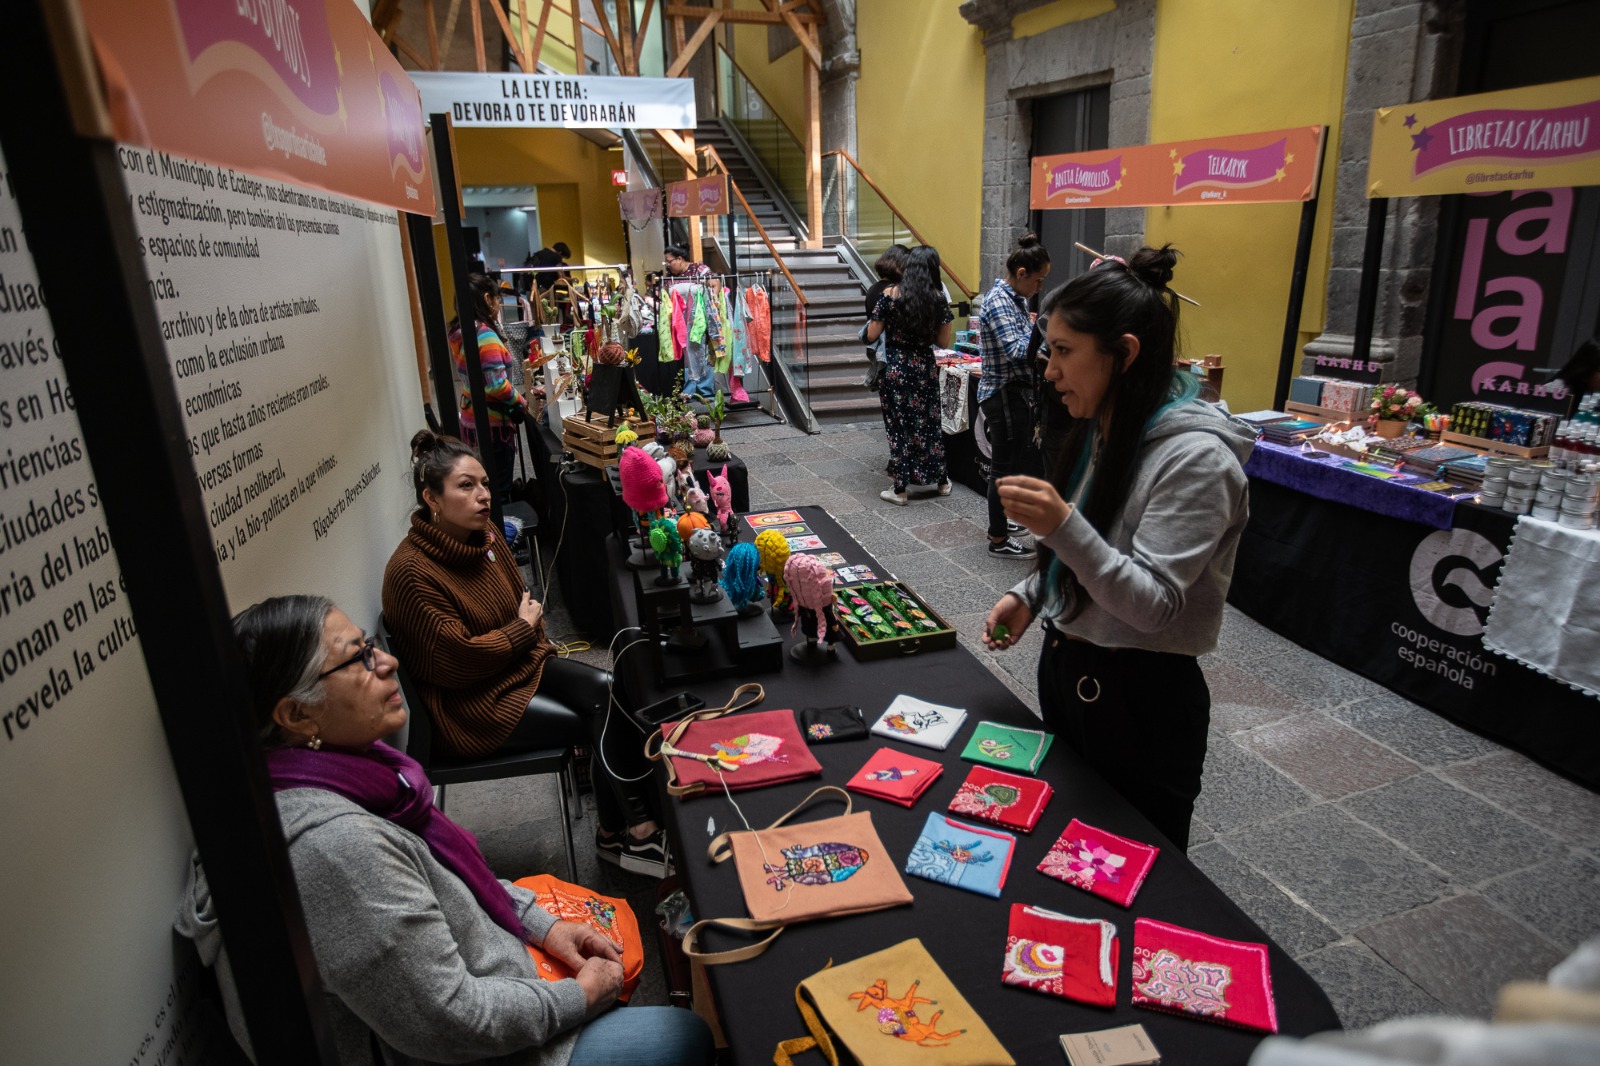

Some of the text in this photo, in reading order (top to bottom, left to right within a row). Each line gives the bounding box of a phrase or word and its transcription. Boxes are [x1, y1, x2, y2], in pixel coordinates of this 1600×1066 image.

[502, 80, 588, 100] LA LEY ERA:
[452, 102, 636, 122] DEVORA O TE DEVORARÁN
[1449, 117, 1590, 155] LIBRETAS KARHU
[118, 147, 144, 174] con
[146, 148, 158, 176] el
[158, 150, 214, 192] Municipio
[217, 166, 228, 190] de
[228, 169, 267, 202] Ecatepec,
[266, 186, 278, 202] nos
[311, 196, 318, 210] en
[1055, 167, 1110, 188] ANITA EMBROLLOS
[1208, 154, 1248, 178] TELKARYK
[138, 190, 226, 226] estigmatización,
[226, 208, 247, 230] pero
[246, 208, 276, 230] también
[286, 212, 296, 232] las
[296, 217, 322, 236] presencias
[148, 232, 198, 262] espacios
[199, 233, 211, 256] de
[213, 236, 260, 258] comunidad
[162, 311, 206, 340] archivo
[206, 314, 214, 336] y
[216, 307, 228, 330] de
[227, 306, 238, 328] la
[239, 304, 260, 326] obra
[260, 302, 270, 322] de
[269, 300, 294, 322] artistas
[176, 331, 286, 379] como la exclusión urbana
[1315, 354, 1380, 374] KARHU
[17, 393, 44, 424] en
[186, 380, 242, 418] económicas
[1480, 377, 1571, 401] KARHU
[202, 424, 220, 456] que
[220, 413, 247, 442] hasta
[246, 403, 267, 428] años
[266, 393, 297, 420] recientes
[296, 386, 310, 404] eran
[232, 442, 264, 475] formas
[210, 458, 286, 529] ciudad neoliberal,
[312, 498, 346, 542] Rigoberto
[344, 481, 363, 507] Reyes
[228, 534, 236, 561] y
[235, 526, 247, 548] la
[246, 493, 290, 539] bio-política
[290, 486, 299, 502] en
[299, 478, 306, 496] la
[305, 473, 316, 492] que
[41, 543, 73, 590] del
[63, 600, 88, 633] en
[88, 580, 117, 614] las
[1391, 621, 1497, 677] cooperación
[1398, 646, 1474, 690] española
[2, 667, 74, 742] revela
[73, 649, 96, 682] la
